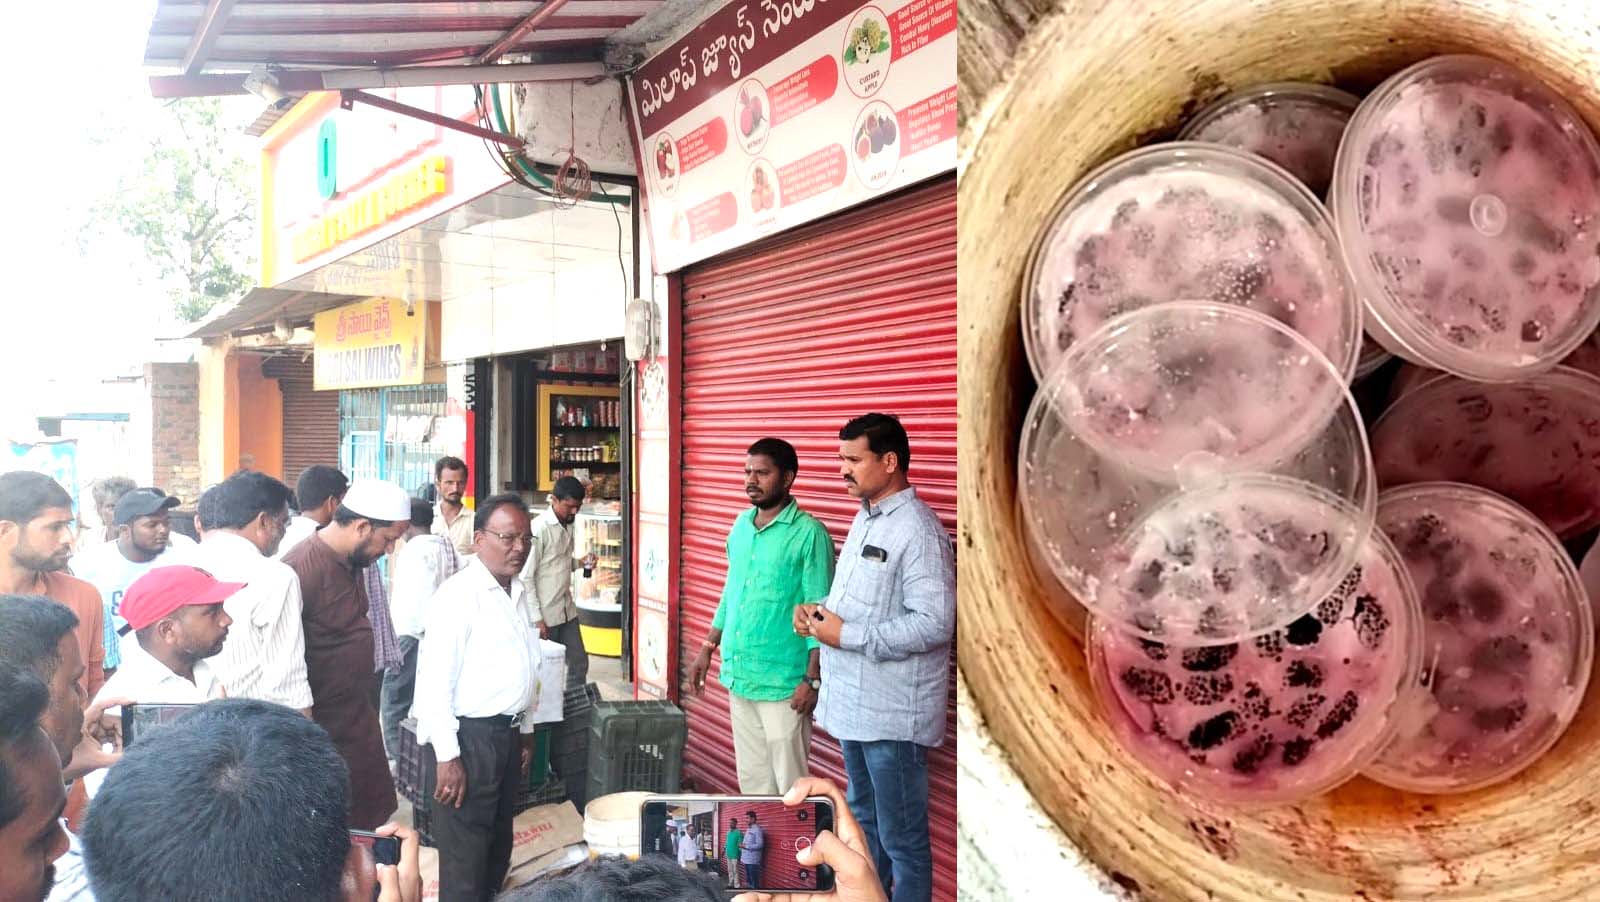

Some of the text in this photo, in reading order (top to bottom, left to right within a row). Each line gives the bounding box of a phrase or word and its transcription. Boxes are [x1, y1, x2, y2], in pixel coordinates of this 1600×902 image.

[642, 0, 828, 117] మిలాప్ జ్యూస్ సెంట
[345, 349, 362, 383] SAI
[365, 343, 402, 380] WINES
